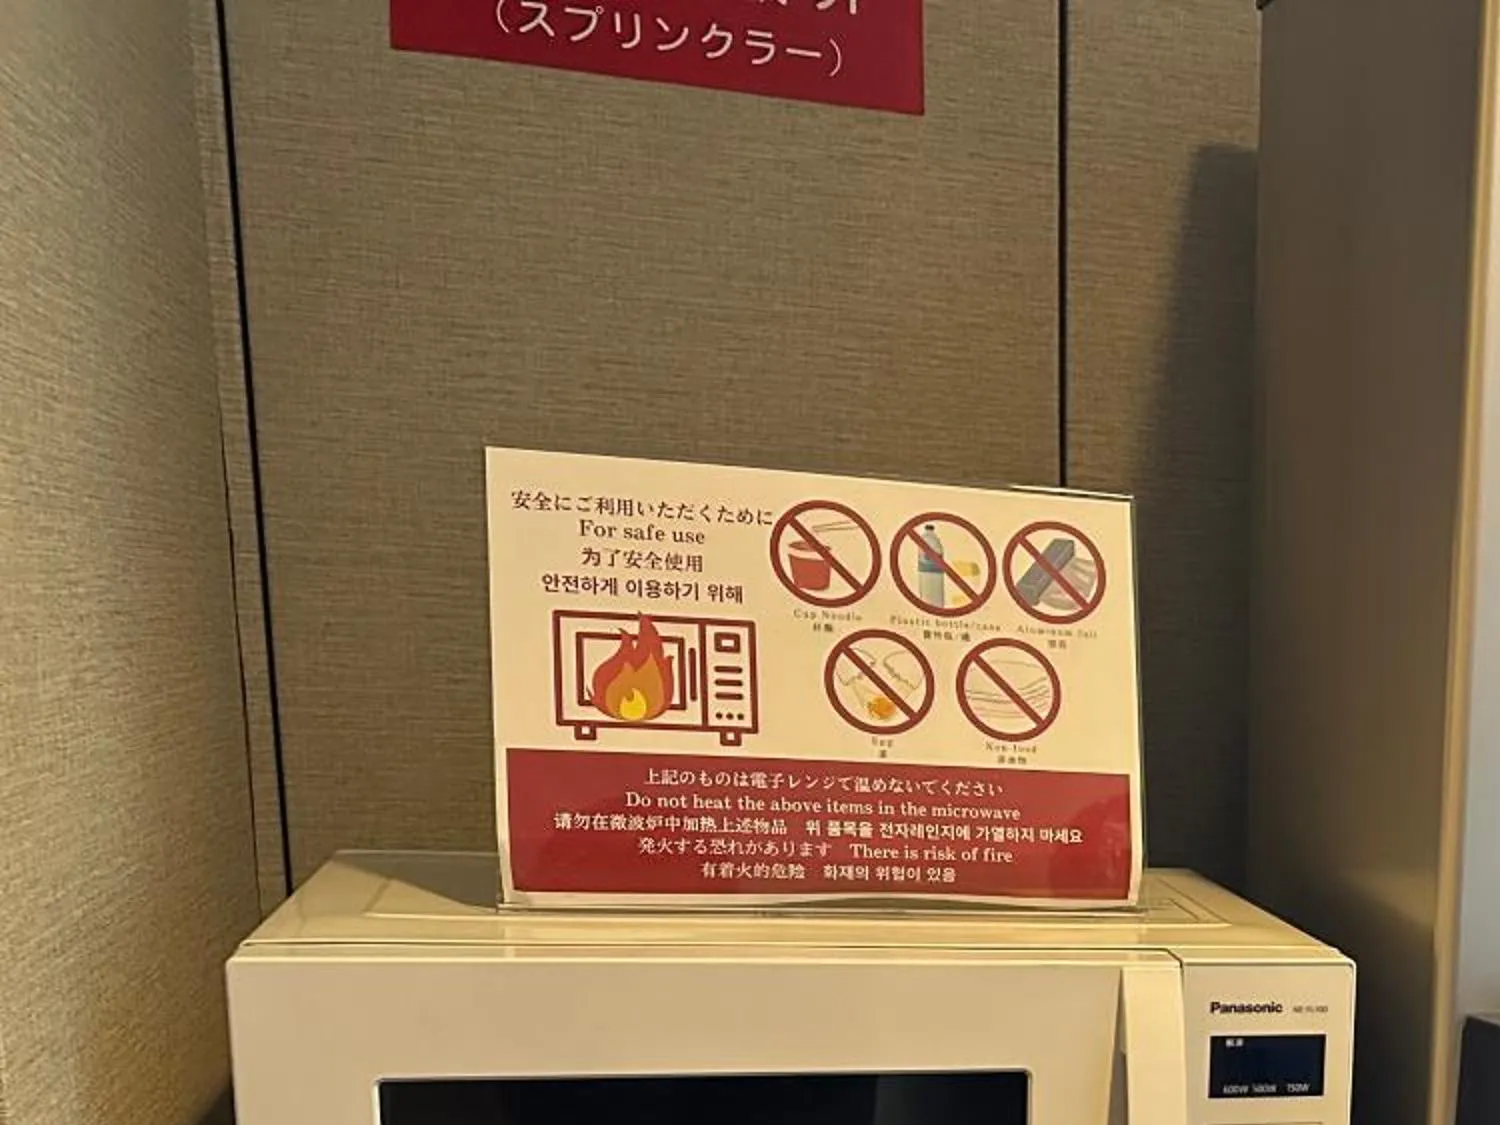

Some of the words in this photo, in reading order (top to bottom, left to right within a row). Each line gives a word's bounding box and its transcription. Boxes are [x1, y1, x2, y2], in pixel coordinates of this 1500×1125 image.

[511, 490, 773, 525] 安全にご利用いただくために
[579, 519, 617, 538] For
[623, 524, 666, 541] safe
[672, 532, 705, 544] use
[581, 548, 703, 572] 为了安全使用
[542, 573, 618, 597] 안전하게
[626, 579, 699, 601] 이용하기
[707, 584, 743, 604] 위해
[644, 769, 1003, 797] 上記のものは電子レンジで温めないでください
[626, 792, 651, 808] Do
[658, 795, 687, 809] not
[694, 794, 731, 810] heat
[737, 796, 764, 811] the
[771, 799, 821, 813] above
[827, 800, 872, 815] items
[879, 802, 894, 815] in
[900, 802, 927, 817] the
[932, 805, 1021, 820] microwave
[806, 820, 820, 835] 위
[827, 821, 873, 837] 품목을
[880, 823, 970, 841] 전자레인지에
[975, 826, 1034, 843] 가열하지
[1040, 828, 1083, 844] 마세요
[639, 837, 832, 857] 発火する恐れがあります
[850, 843, 899, 859] There
[904, 845, 919, 860] is
[924, 846, 955, 861] risk
[962, 848, 977, 862] of
[983, 849, 1013, 863] fire
[824, 864, 869, 881] 화재의
[875, 866, 921, 882] 위험이
[927, 868, 956, 883] 있음
[1210, 1001, 1283, 1014] Panasonic
